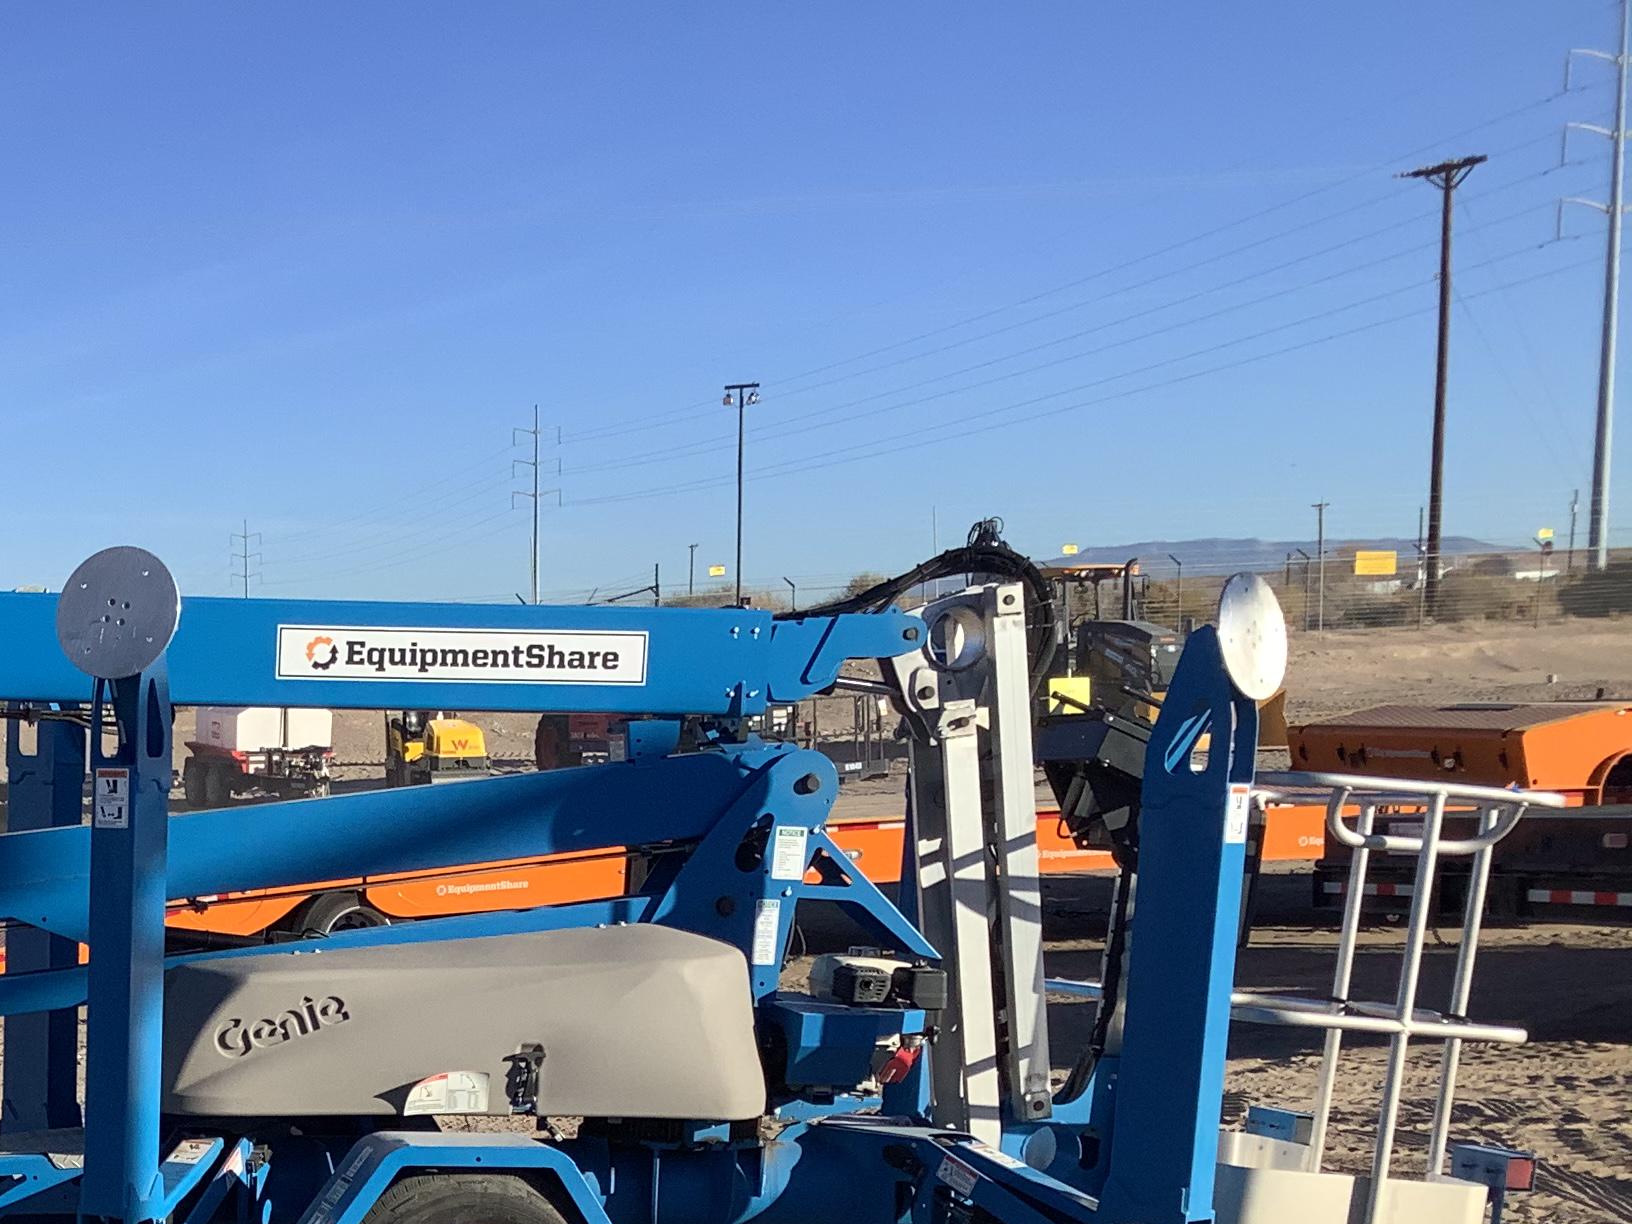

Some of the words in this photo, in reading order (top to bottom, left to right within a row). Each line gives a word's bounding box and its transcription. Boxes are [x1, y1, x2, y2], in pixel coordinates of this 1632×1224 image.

[345, 640, 620, 673] EquipmentShare
[448, 880, 529, 896] EquipmentShare
[214, 995, 350, 1059] Genie
